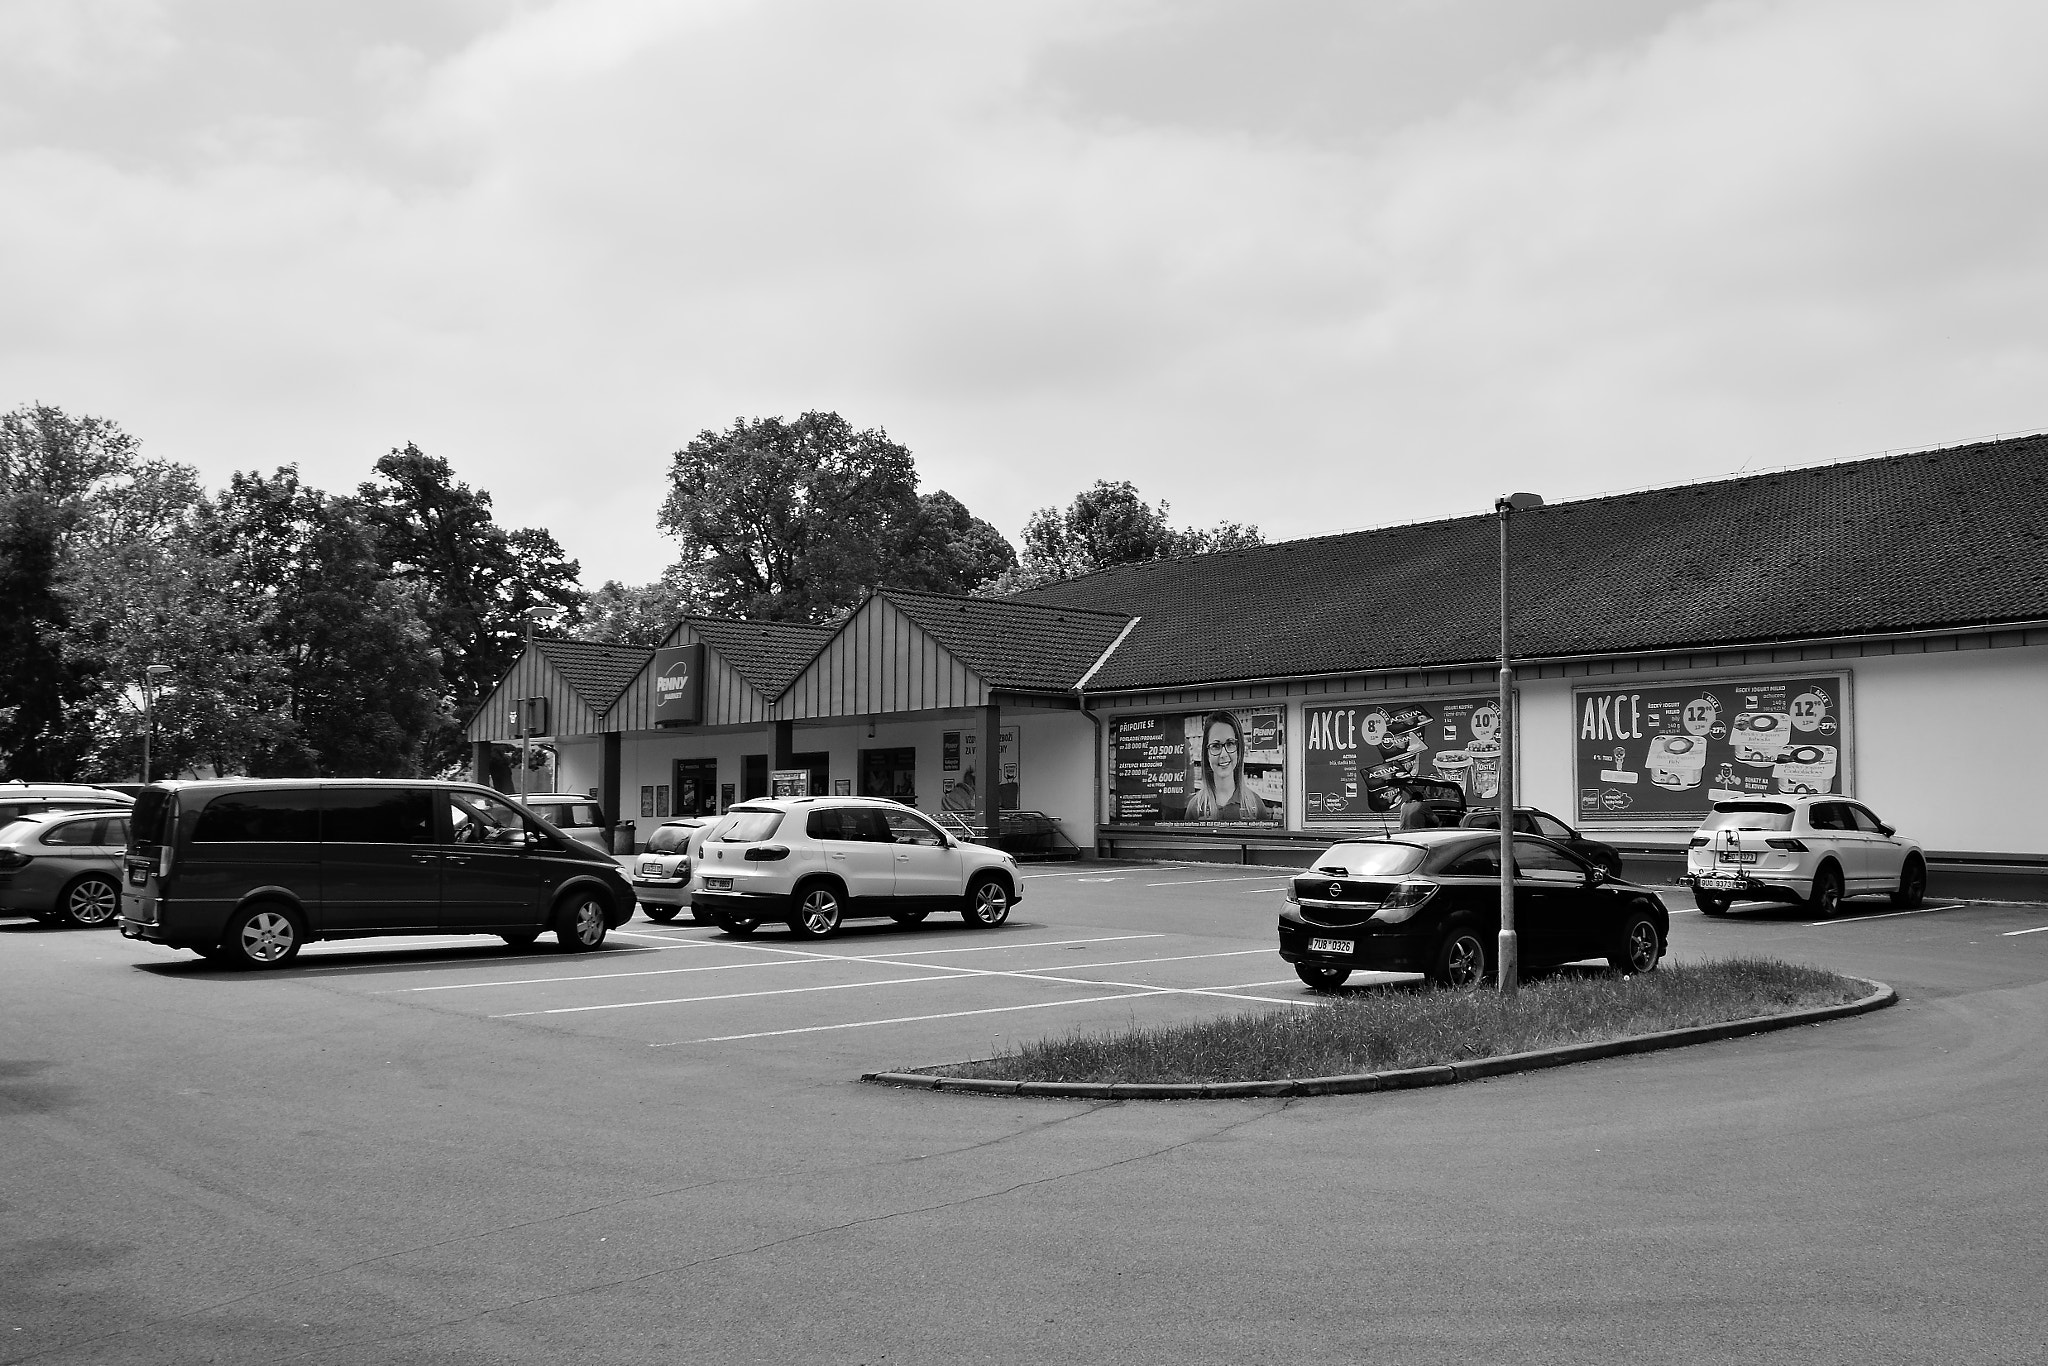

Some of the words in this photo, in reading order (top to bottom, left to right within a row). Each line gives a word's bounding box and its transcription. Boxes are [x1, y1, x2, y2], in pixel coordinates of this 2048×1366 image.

[657, 676, 689, 692] PENNY
[1581, 694, 1642, 740] AKCE
[1119, 721, 1147, 733] PŘIPOJTE
[1147, 719, 1155, 729] SE
[1252, 727, 1277, 737] PENNY
[1308, 710, 1357, 751] AKCE
[1148, 745, 1158, 756] 20
[1158, 745, 1173, 755] 500
[1147, 773, 1158, 783] 24
[1158, 772, 1173, 783] 600
[1369, 766, 1400, 779] ACTIVIA
[1163, 786, 1184, 794] BONUS
[1715, 880, 1732, 888] 9373
[1313, 939, 1328, 950] 7U8
[1332, 940, 1351, 952] 0326
